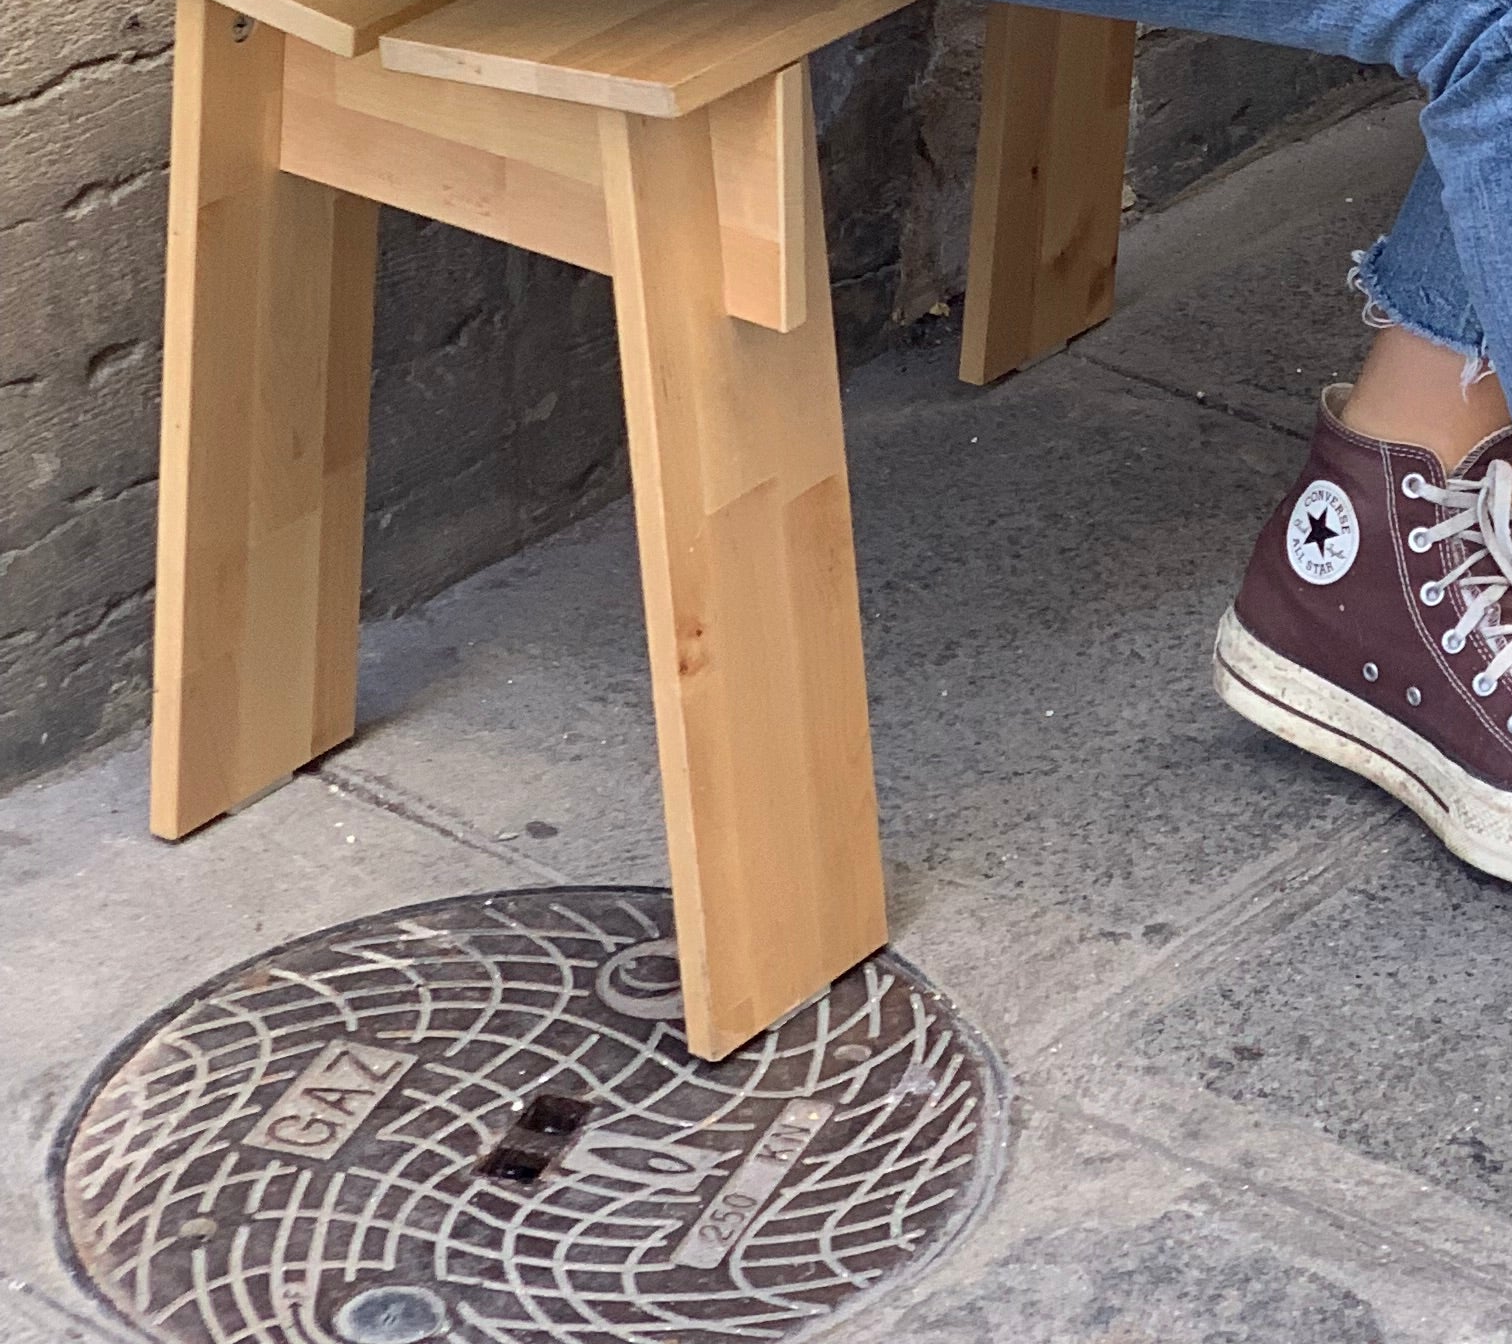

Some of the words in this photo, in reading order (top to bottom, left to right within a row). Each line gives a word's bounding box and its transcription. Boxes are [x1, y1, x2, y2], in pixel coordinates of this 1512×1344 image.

[1304, 489, 1351, 535] CONVERSE
[1293, 538, 1305, 564] ALL
[1305, 559, 1334, 576] STAR
[265, 1049, 403, 1147] GAZ
[699, 1192, 758, 1242] 250
